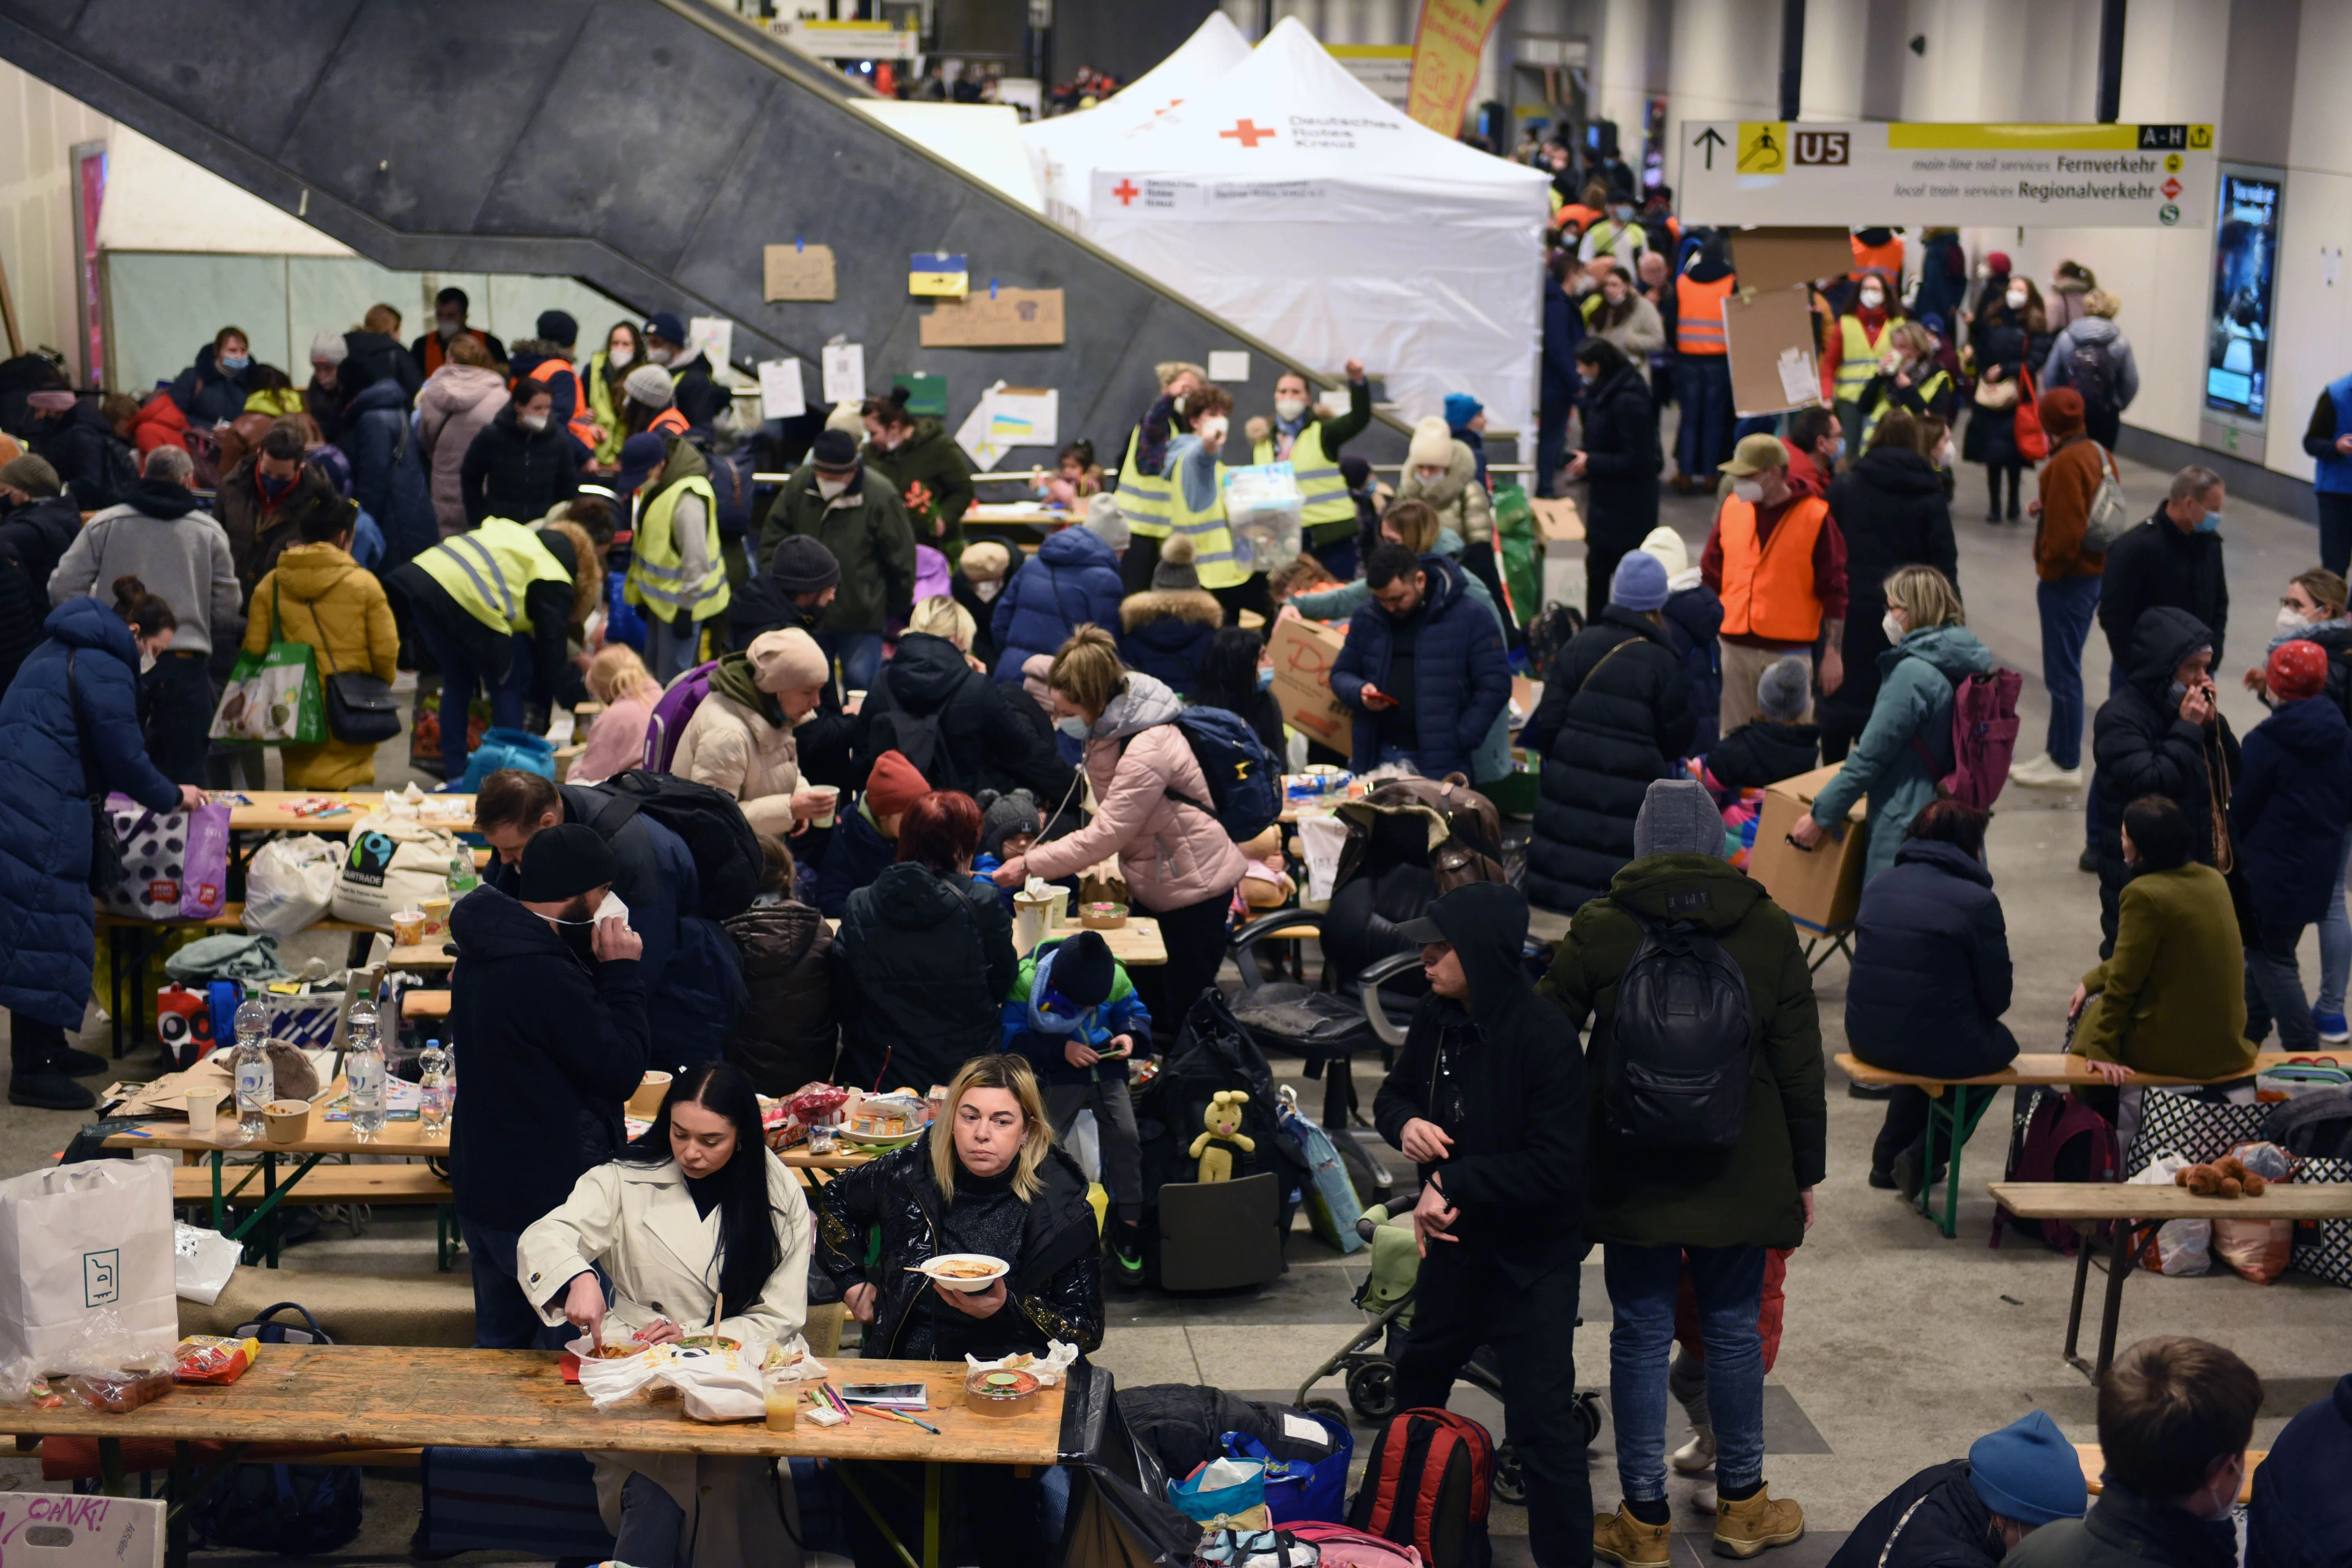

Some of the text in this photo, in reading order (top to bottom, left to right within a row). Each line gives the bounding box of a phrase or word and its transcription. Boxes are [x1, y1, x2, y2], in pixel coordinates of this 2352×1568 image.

[1800, 134, 1844, 163] U5
[1912, 155, 2157, 173] main-line rail services Fernverkehr
[1893, 182, 1926, 196] local
[1929, 182, 1959, 196] train
[1964, 183, 2014, 196] services
[2019, 180, 2155, 203] Regionalverkehr
[343, 869, 383, 886] FAIRTRADE
